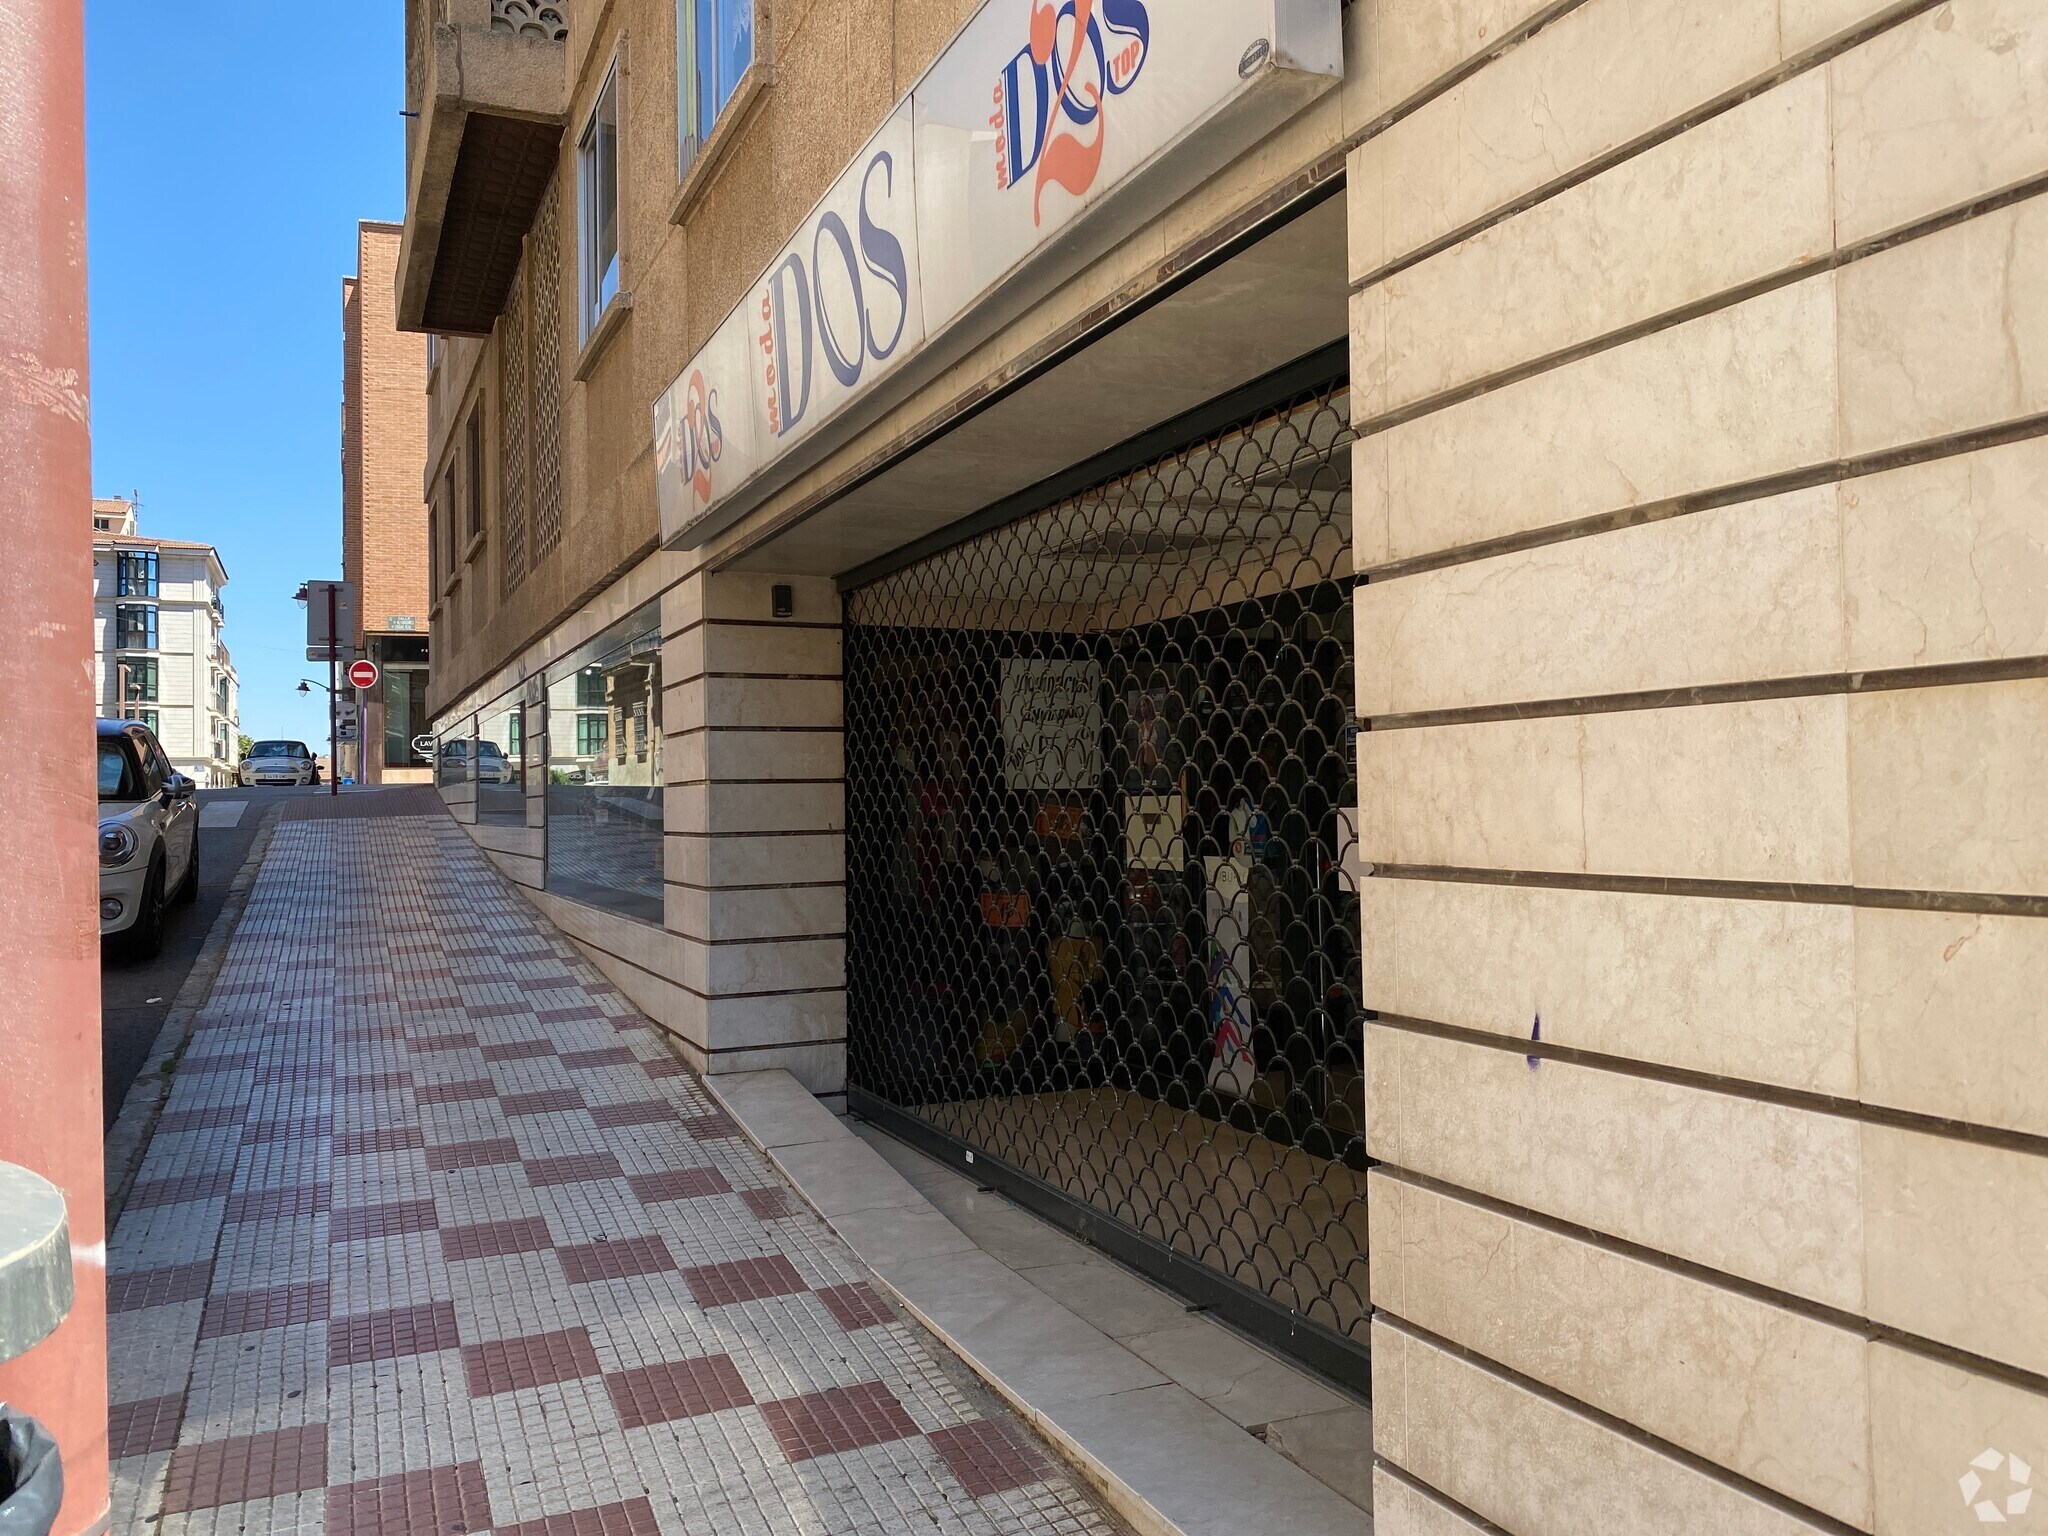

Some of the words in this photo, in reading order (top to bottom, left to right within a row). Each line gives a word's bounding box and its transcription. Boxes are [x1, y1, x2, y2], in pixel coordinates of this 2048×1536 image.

[1112, 40, 1140, 83] TOP
[988, 78, 1008, 190] moda
[768, 150, 908, 438] DOS
[759, 288, 779, 434] moda
[680, 388, 723, 486] DOS
